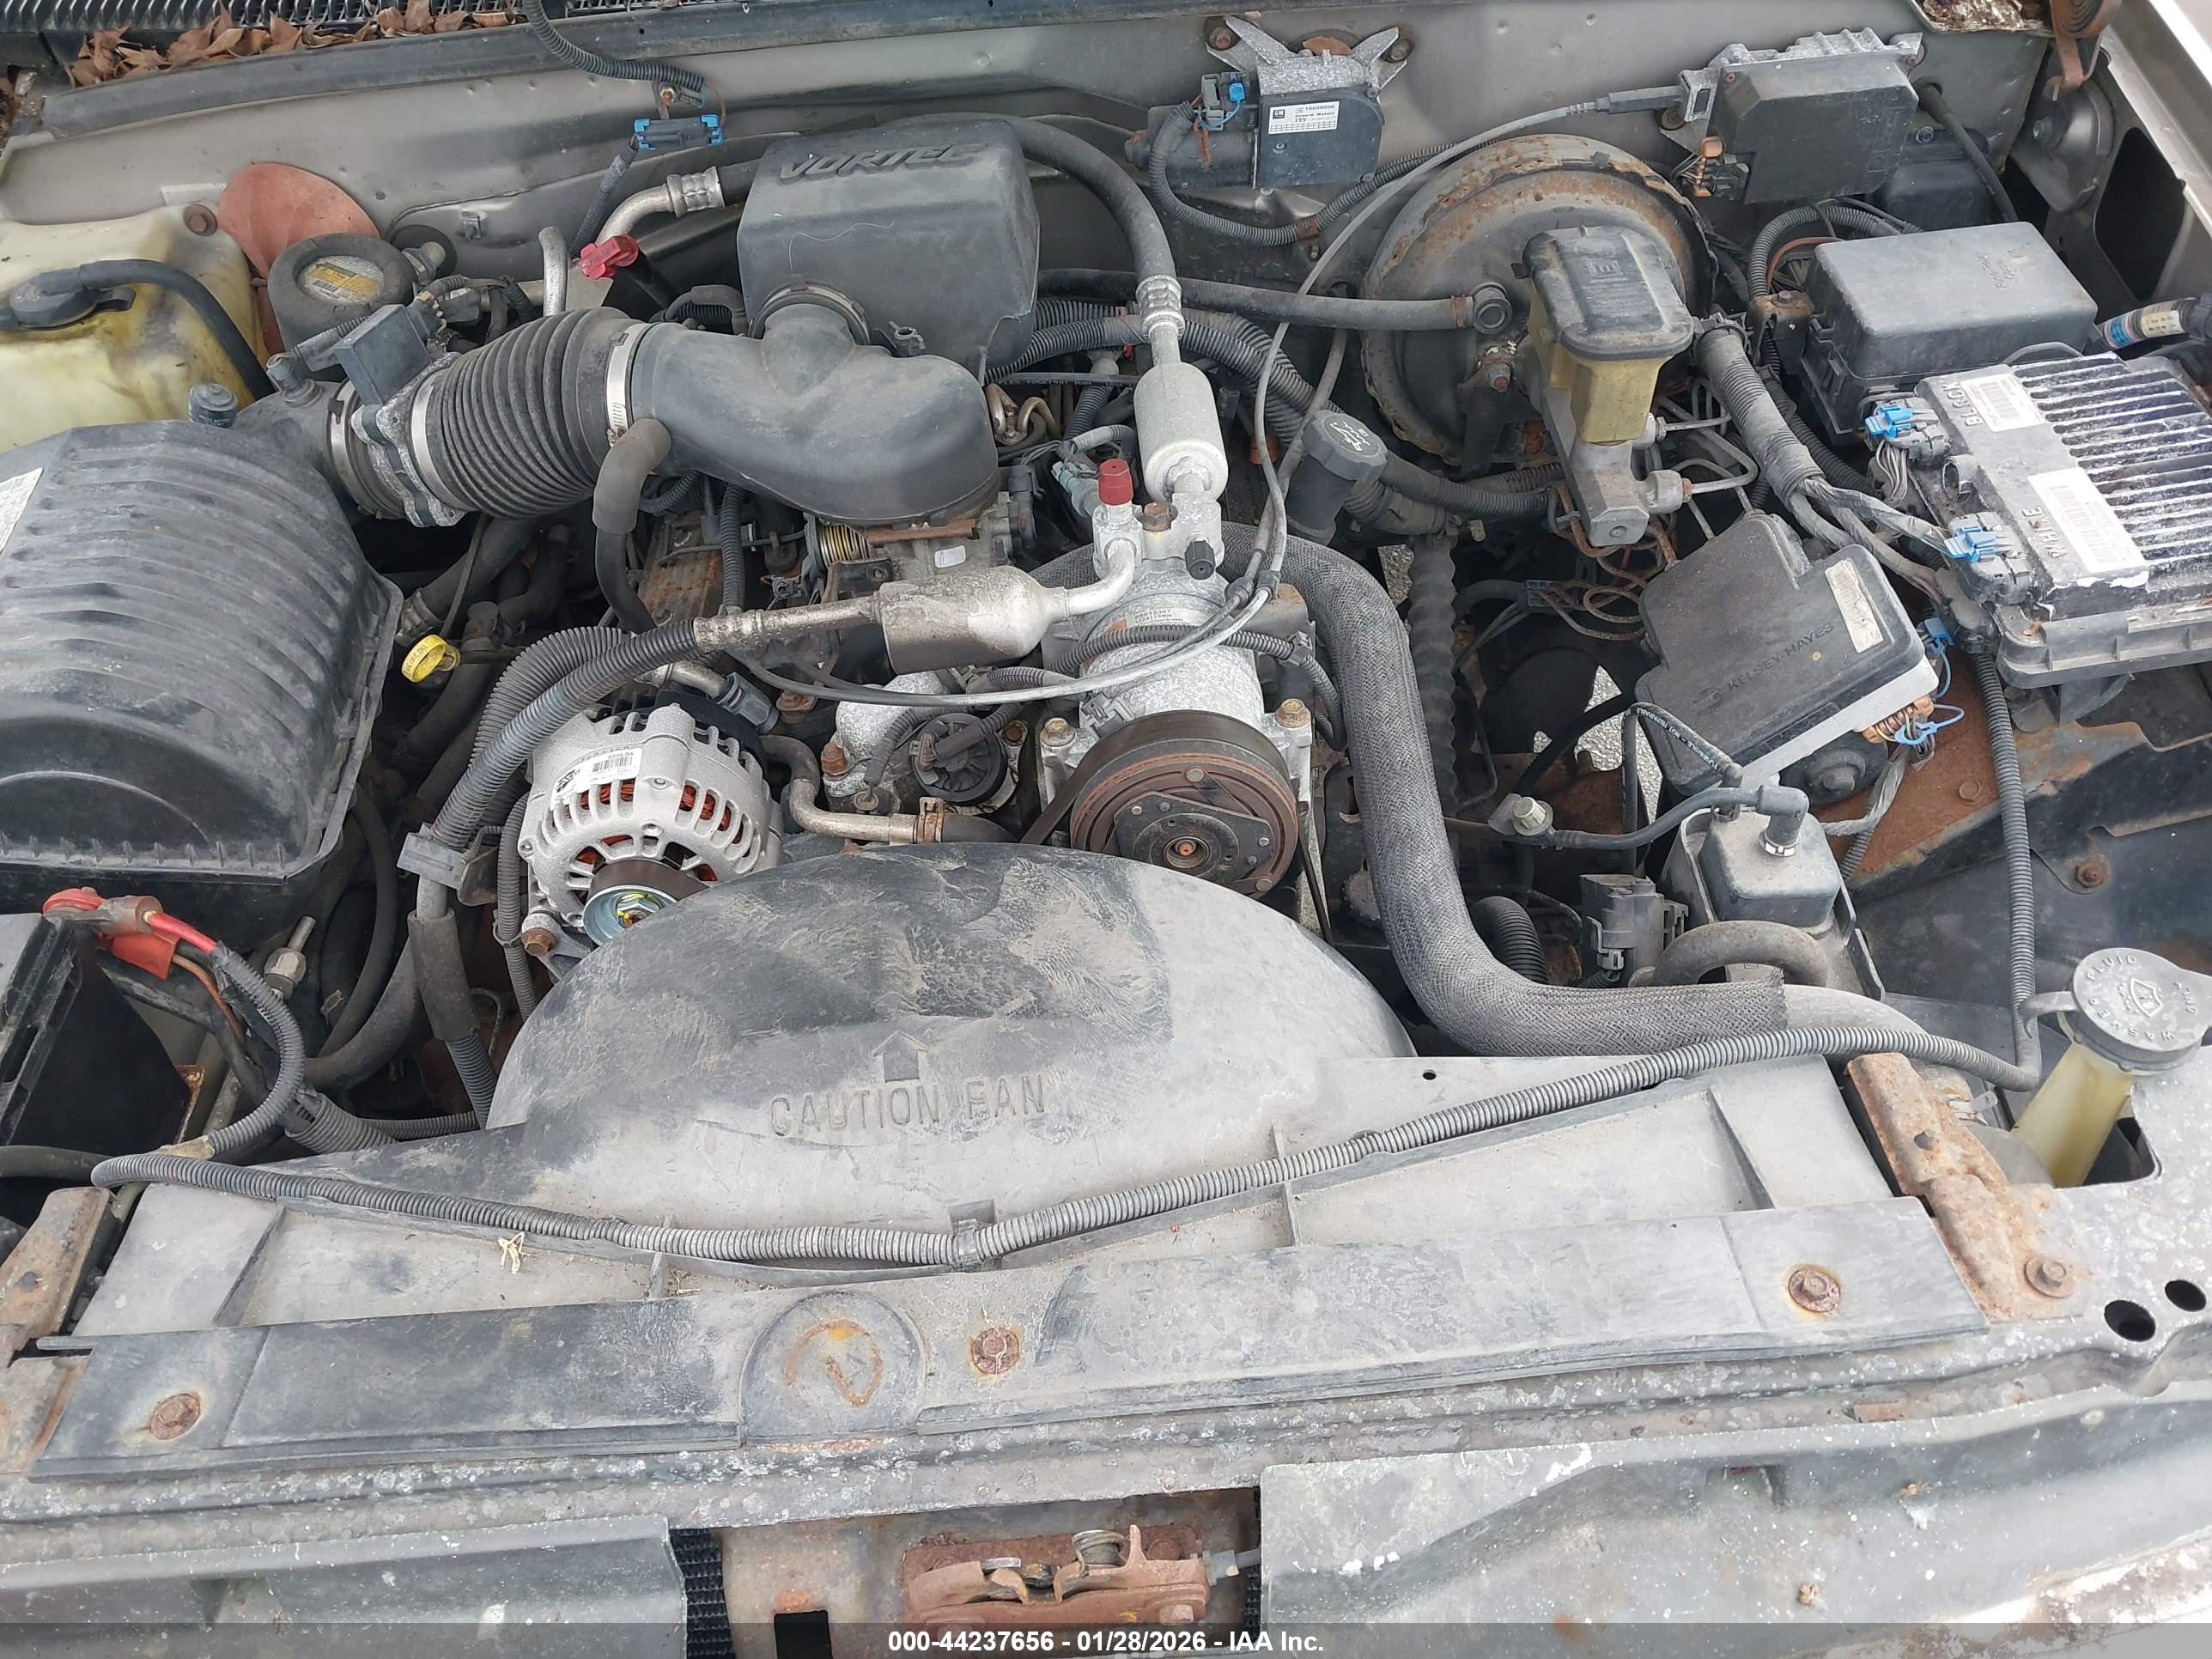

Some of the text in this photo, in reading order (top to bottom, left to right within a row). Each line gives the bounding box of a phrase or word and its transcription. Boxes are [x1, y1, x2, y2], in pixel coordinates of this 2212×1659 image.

[1273, 109, 1285, 118] GM
[777, 143, 989, 185] VORTEC
[1941, 382, 1984, 427] BLACK
[1728, 622, 1835, 691] KELSEY-HAYES
[2086, 954, 2137, 982] FLUID
[771, 1073, 1045, 1137] CAUTION FAN
